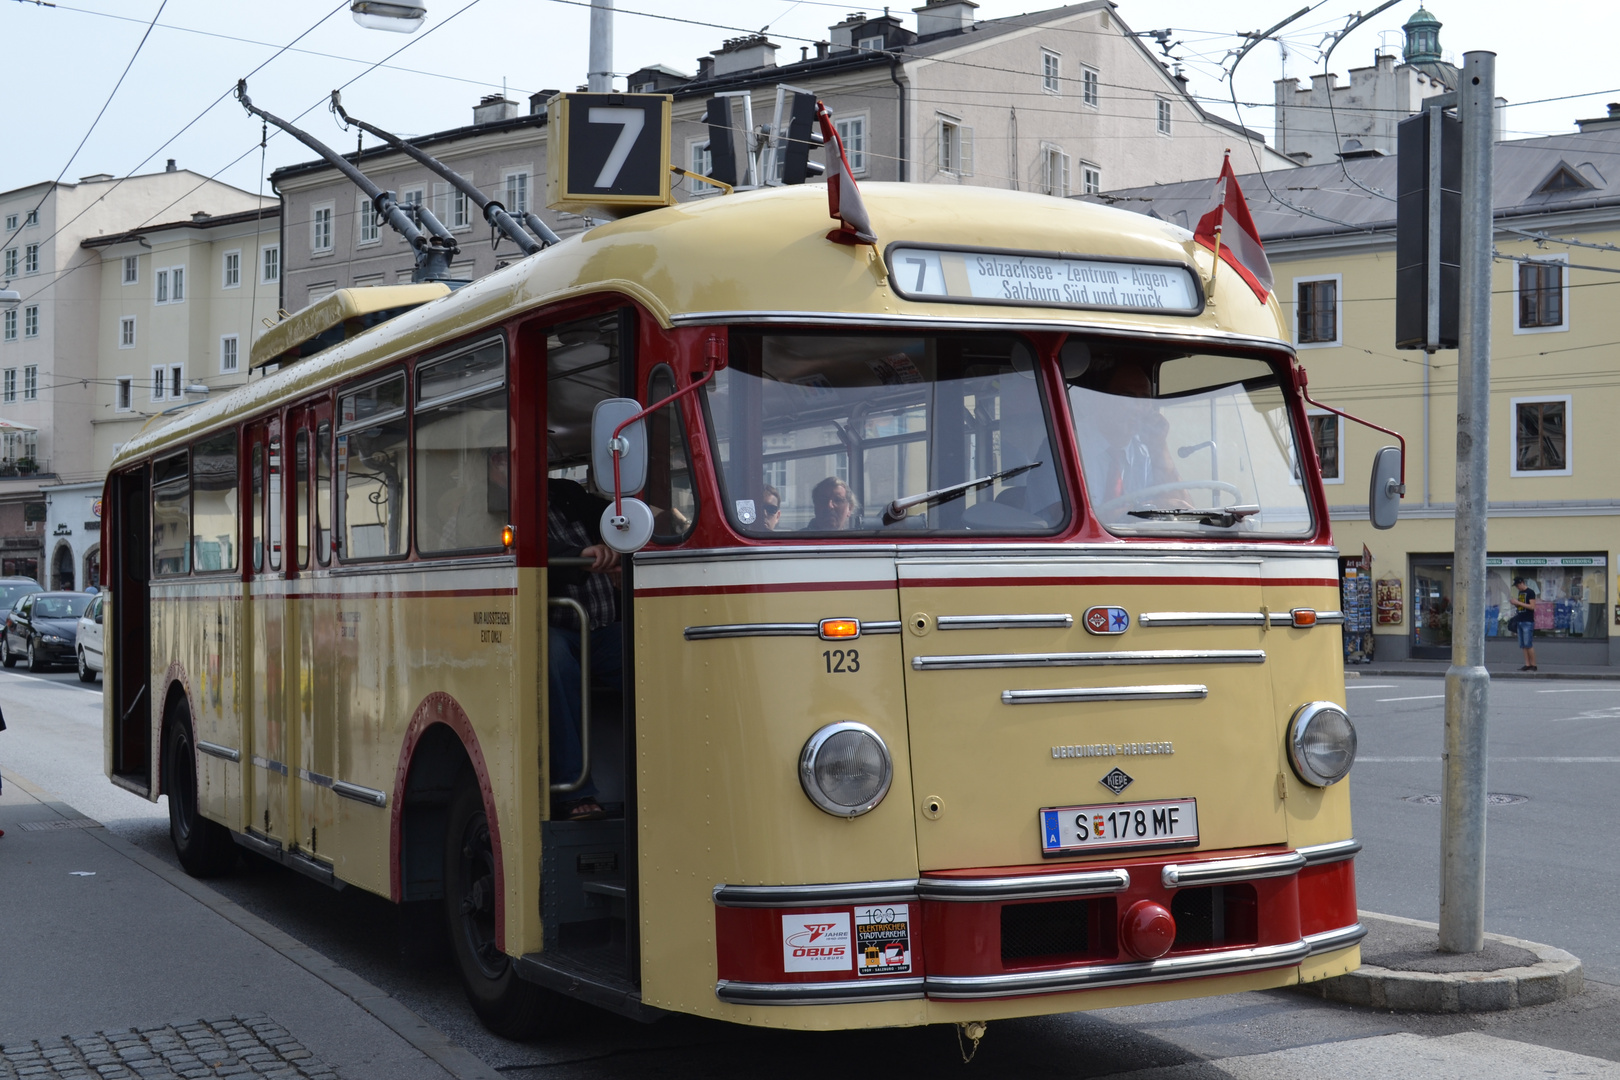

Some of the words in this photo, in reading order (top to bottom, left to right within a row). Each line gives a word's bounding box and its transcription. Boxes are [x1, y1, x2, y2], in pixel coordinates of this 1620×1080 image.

[588, 107, 645, 188] 7
[905, 257, 927, 292] 7
[977, 256, 1053, 280] Salzachsee
[1064, 262, 1119, 285] Zentrum
[1132, 267, 1169, 291] Aigen
[1002, 279, 1061, 302] Salzburg
[1063, 283, 1089, 304] Süd
[1092, 286, 1118, 305] und
[1120, 288, 1164, 308] zurück
[473, 611, 482, 624] NUR
[480, 630, 490, 643] EXIT
[823, 649, 860, 673] 123
[1107, 775, 1128, 786] KIEPE
[1075, 813, 1089, 841] S
[1107, 809, 1147, 838] 178
[1152, 806, 1180, 835] MF
[1050, 834, 1057, 843] A
[866, 908, 895, 924] 100
[810, 925, 828, 934] 70
[858, 923, 906, 933] ELEKTRISCHER
[859, 930, 907, 940] STADTVERKEHR
